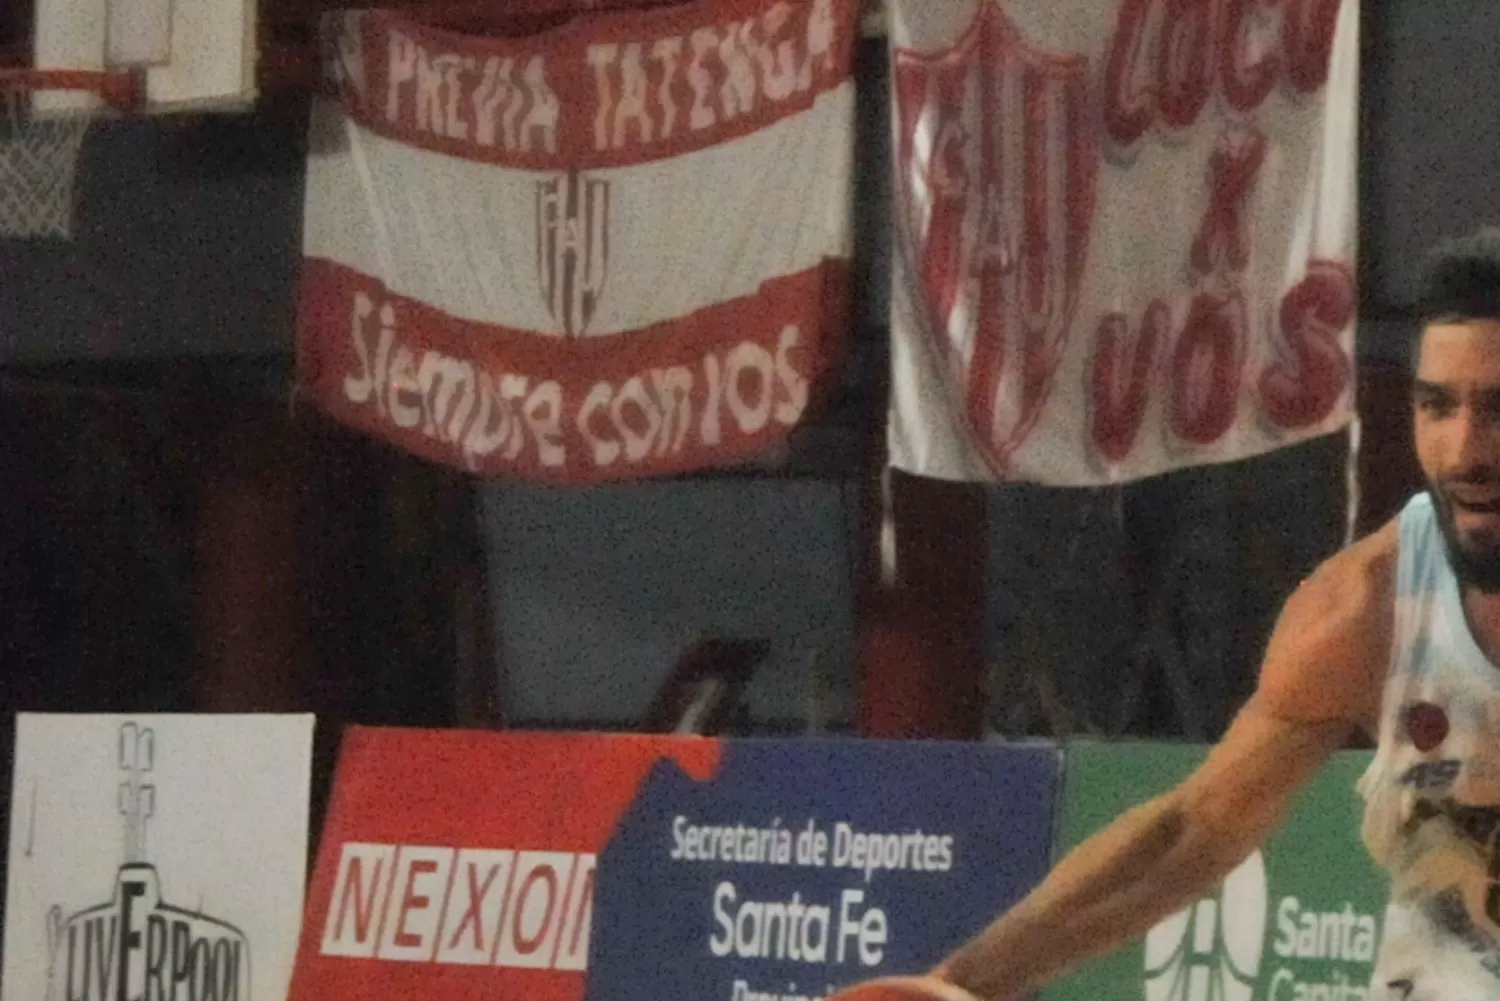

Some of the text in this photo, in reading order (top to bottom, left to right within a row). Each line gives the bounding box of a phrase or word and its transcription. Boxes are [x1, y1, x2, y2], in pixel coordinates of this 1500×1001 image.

[1090, 258, 1352, 462] VOS
[577, 364, 693, 468] con
[670, 814, 955, 883] Secretaría de Deportes
[709, 880, 888, 967] Santa Fe
[1273, 895, 1376, 962] Santa
